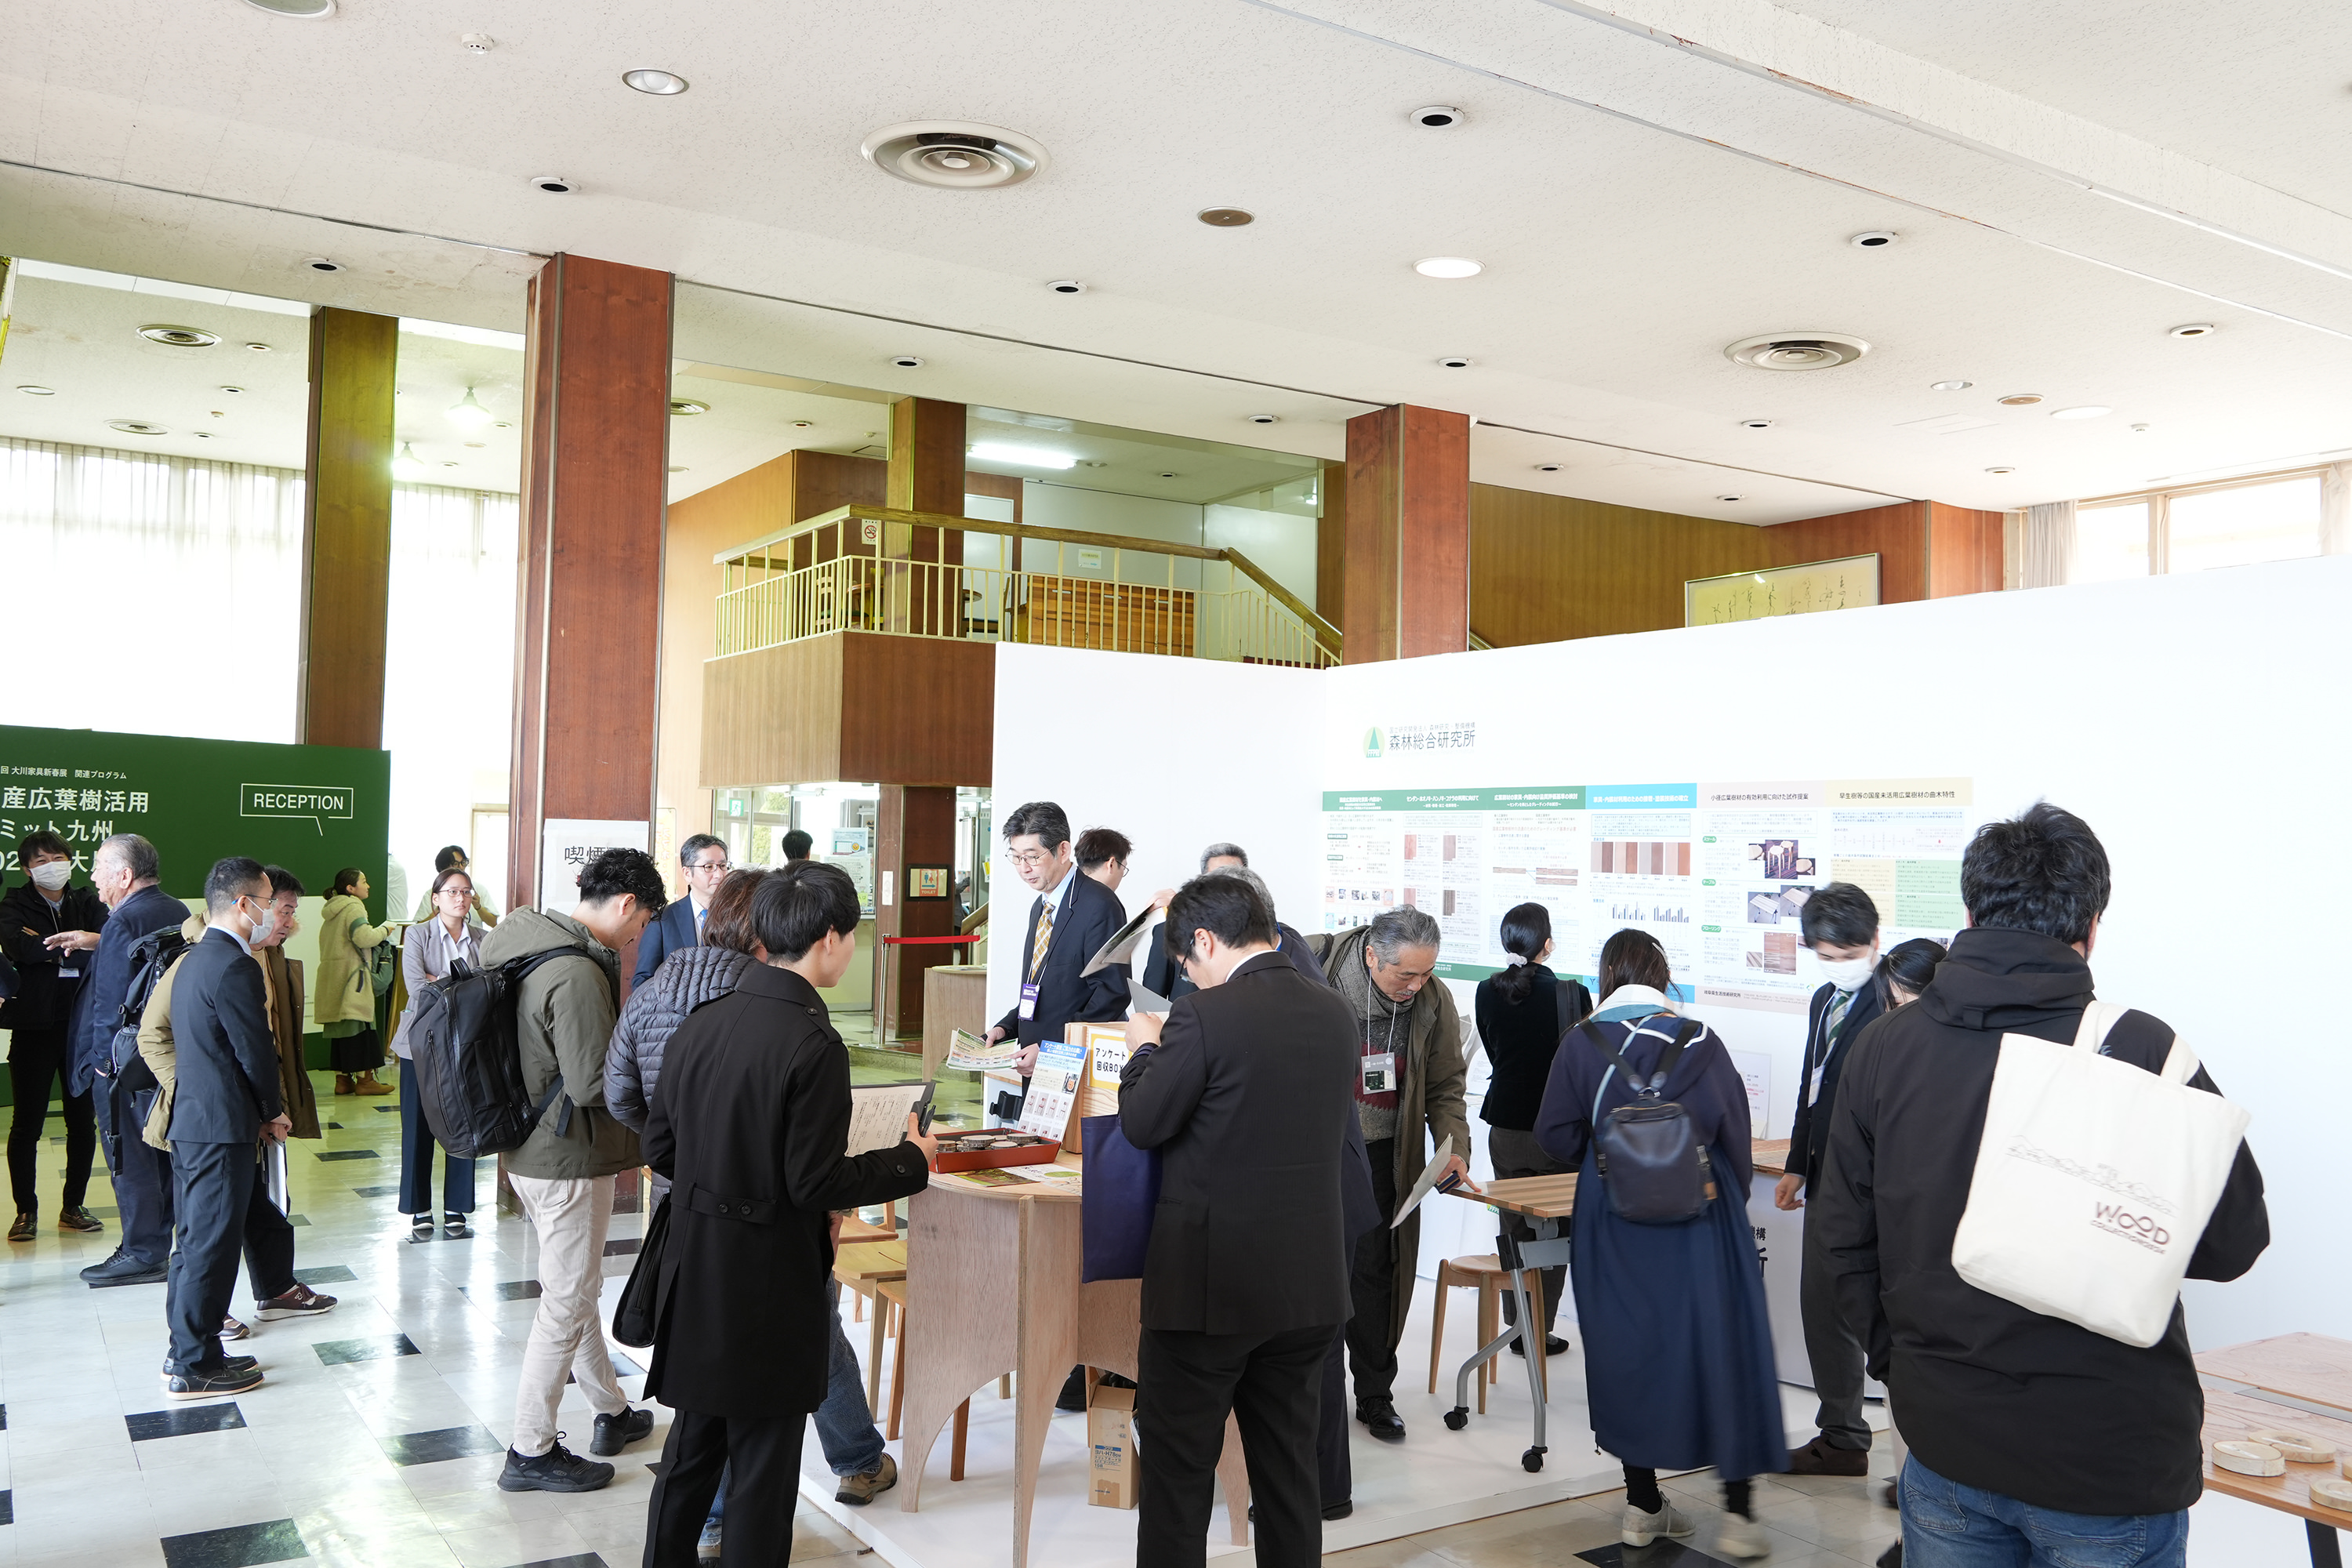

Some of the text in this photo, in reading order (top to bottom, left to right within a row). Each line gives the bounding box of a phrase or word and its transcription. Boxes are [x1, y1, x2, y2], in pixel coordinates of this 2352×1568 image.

[1388, 730, 1475, 751] 森林総合研究所
[11, 766, 67, 778] 大川家具新春展
[74, 769, 127, 779] 関連プログラム
[2, 786, 149, 813] 産広葉樹活用
[253, 793, 343, 810] RECEPTION
[1711, 793, 1809, 801] 小径広葉樹材の有効利用に向けた試作提案
[1839, 791, 1955, 800] 早生樹等の国産未活用広葉樹材の曲木特性
[1095, 1047, 1127, 1061] アンケート
[2096, 1201, 2170, 1245] WOOD
